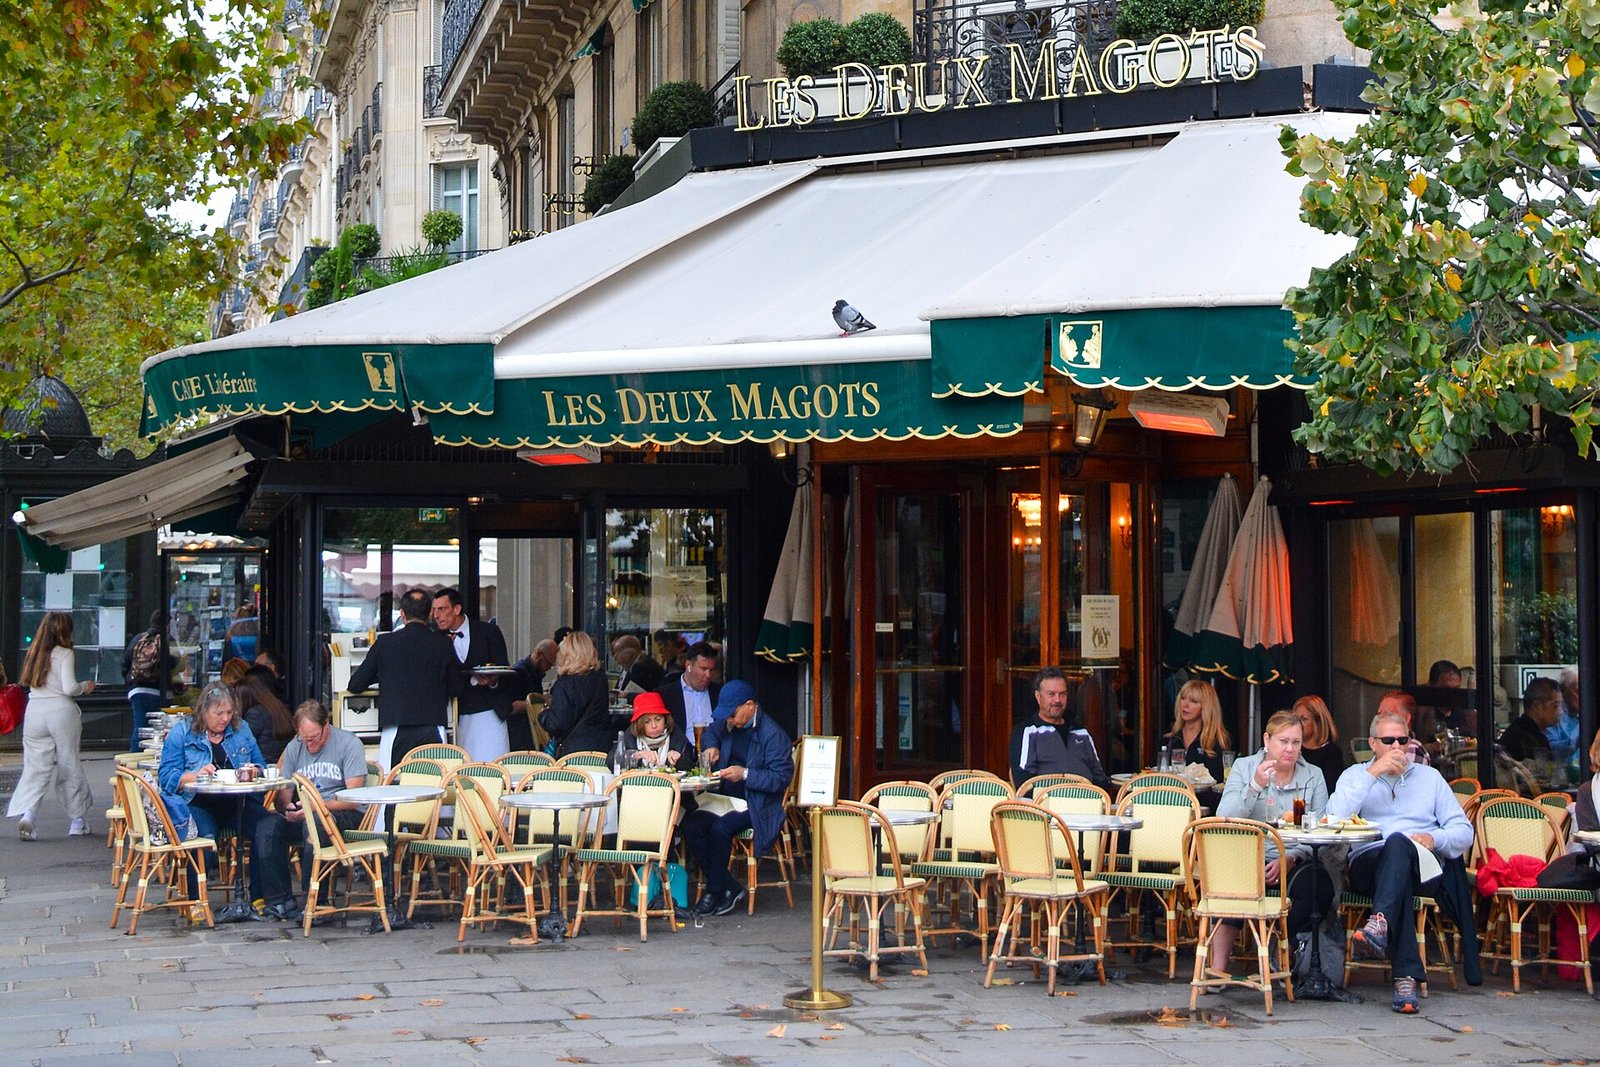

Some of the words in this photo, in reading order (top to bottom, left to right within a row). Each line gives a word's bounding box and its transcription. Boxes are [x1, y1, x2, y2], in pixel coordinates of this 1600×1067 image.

[734, 75, 816, 131] LES
[833, 55, 991, 122] DEUX
[1006, 24, 1258, 103] MAGOTS
[540, 389, 607, 426] LES
[615, 387, 717, 425] DEUX
[727, 381, 881, 421] MAGOTS
